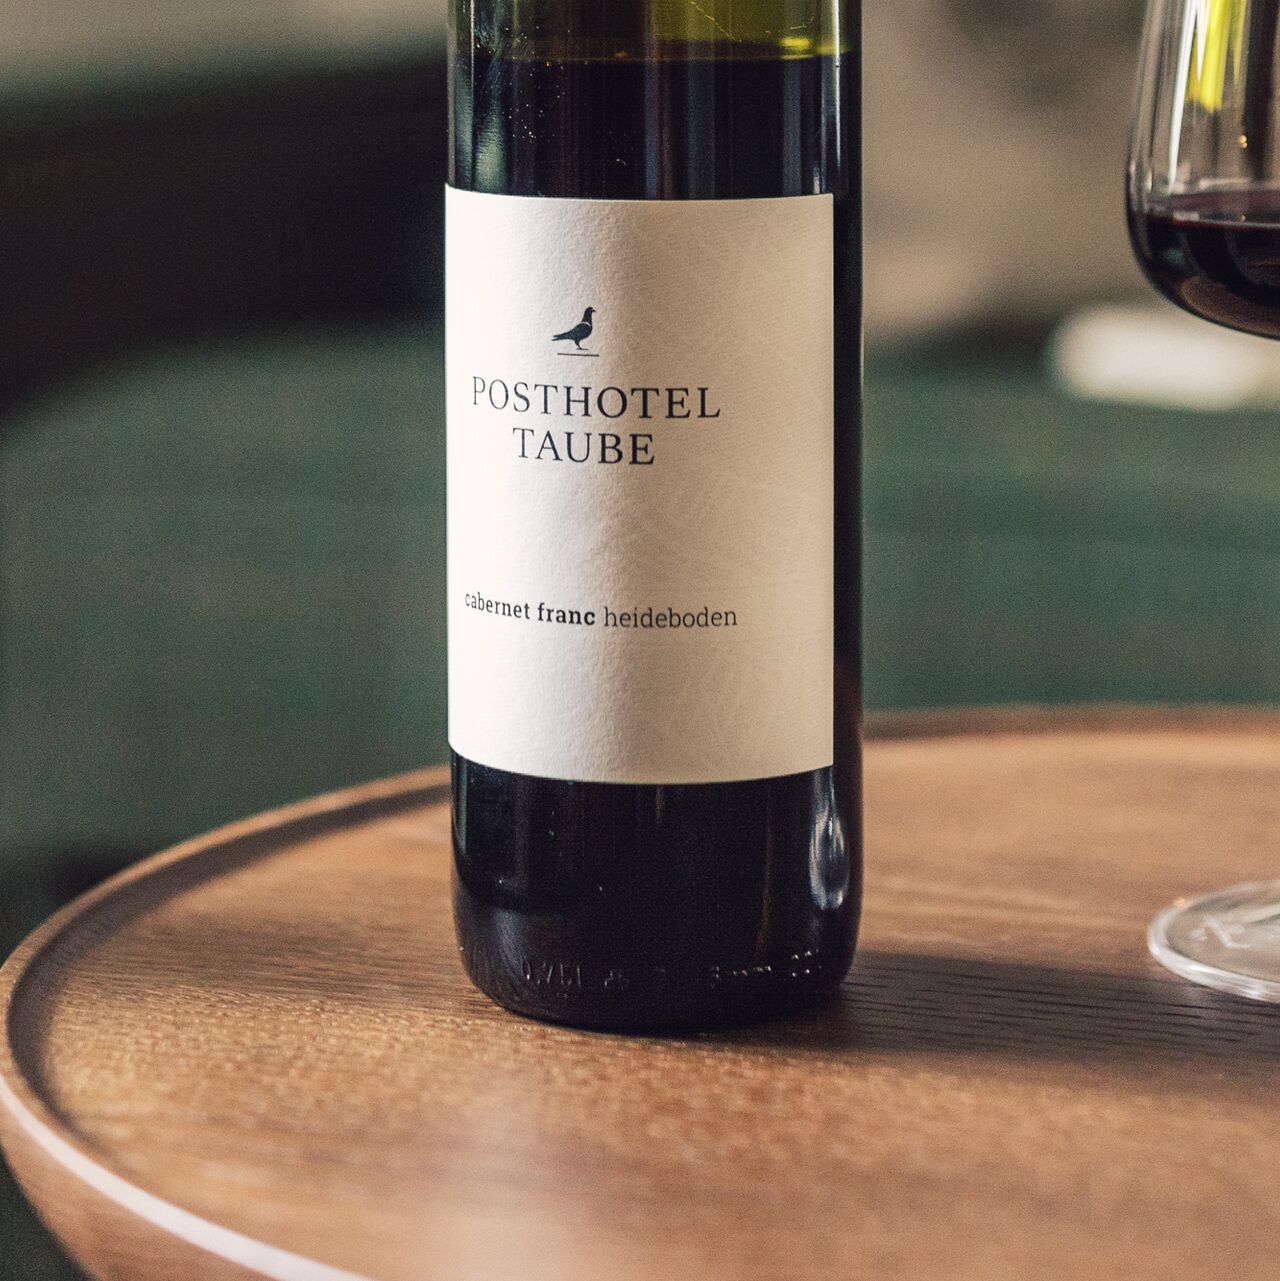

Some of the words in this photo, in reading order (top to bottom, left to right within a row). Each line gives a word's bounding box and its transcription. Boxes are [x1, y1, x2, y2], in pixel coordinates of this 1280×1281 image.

[472, 375, 721, 419] POSTHOTEL
[512, 427, 655, 465] TAUBE
[465, 591, 530, 620] cabernet
[537, 602, 595, 626] franc
[604, 606, 738, 628] heideboden
